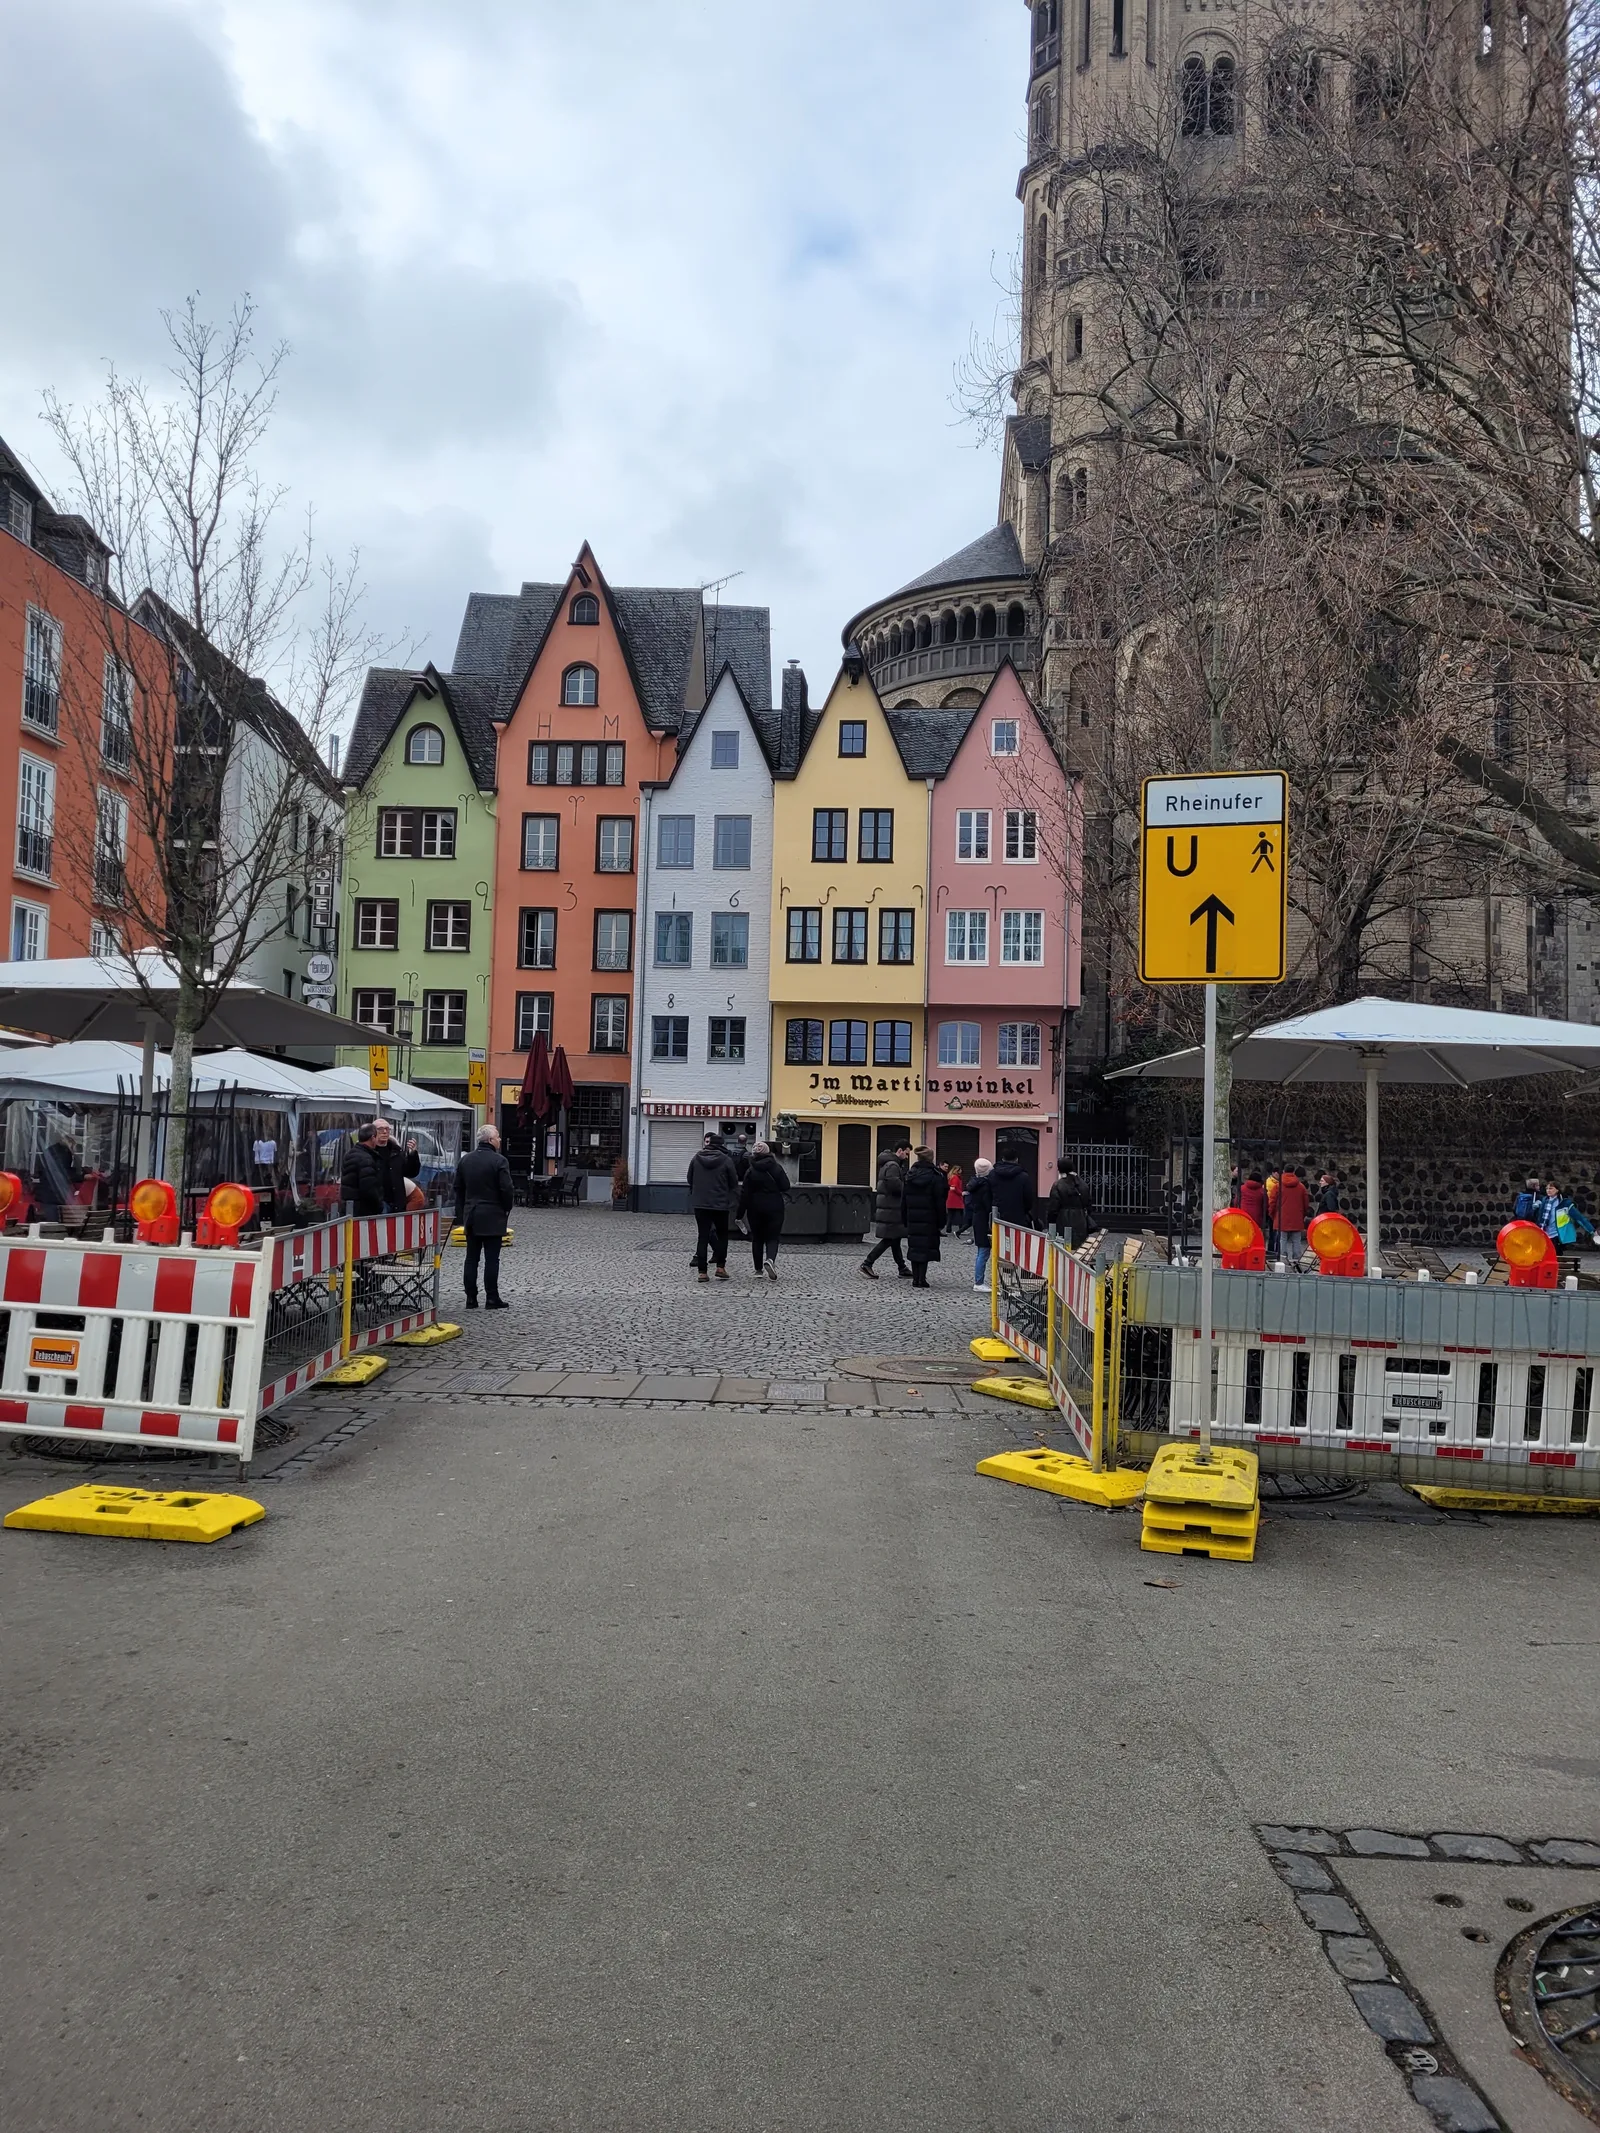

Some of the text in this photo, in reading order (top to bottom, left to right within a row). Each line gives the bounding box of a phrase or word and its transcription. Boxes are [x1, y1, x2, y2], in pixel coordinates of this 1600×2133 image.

[1166, 793, 1263, 812] Rheinufer
[1167, 835, 1198, 877] U
[850, 1074, 1034, 1094] Martinswinkel
[655, 1105, 671, 1115] Eis
[695, 1106, 711, 1116] Eis
[735, 1107, 751, 1117] Eis
